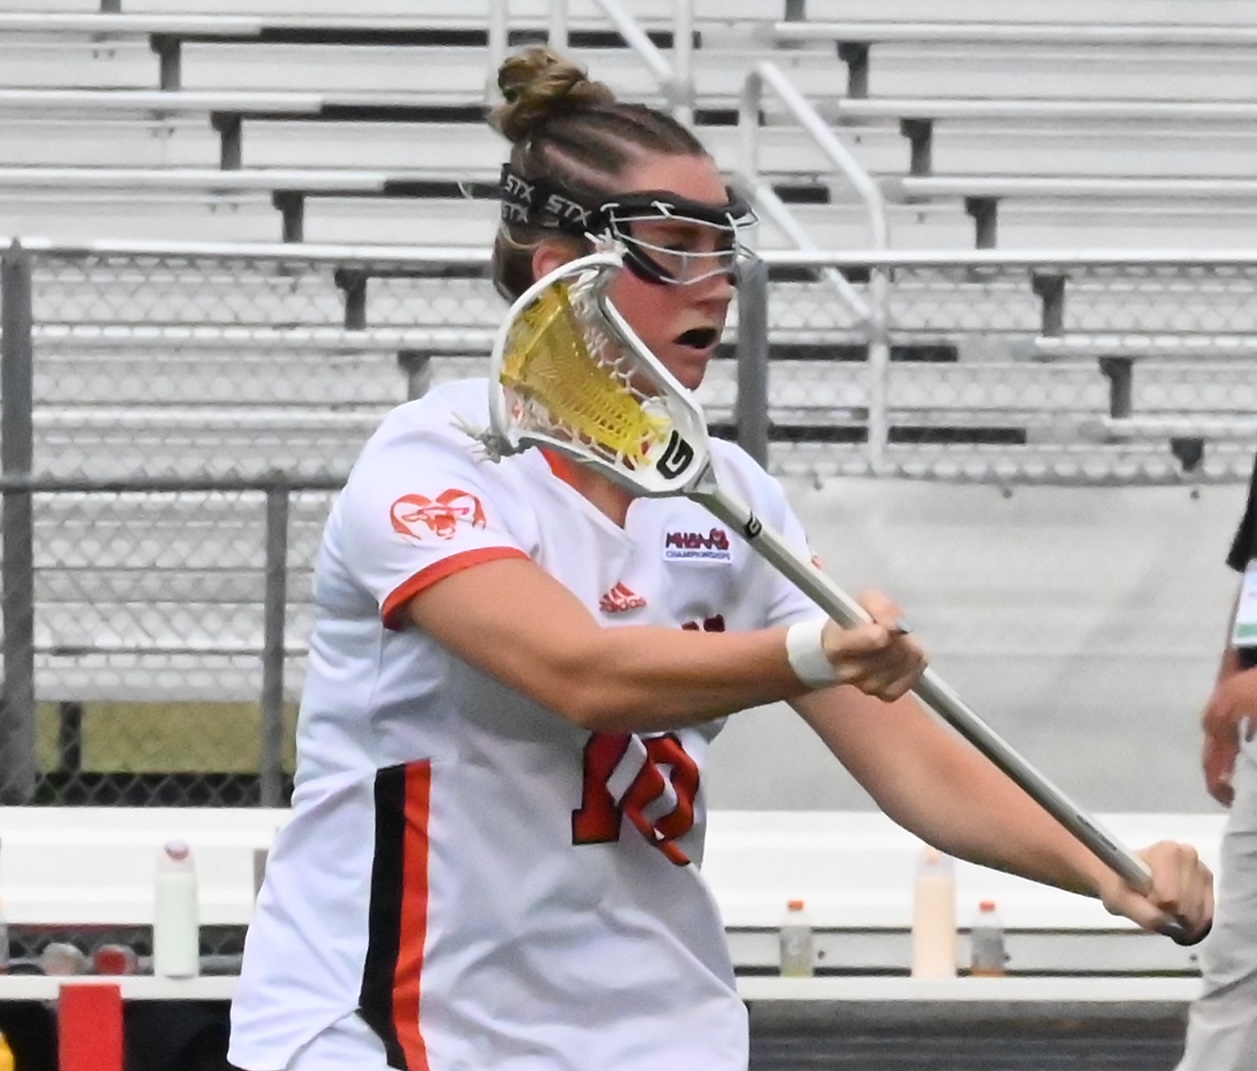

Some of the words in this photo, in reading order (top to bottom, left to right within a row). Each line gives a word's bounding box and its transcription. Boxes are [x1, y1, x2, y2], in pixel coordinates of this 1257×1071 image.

[503, 174, 535, 203] STX
[545, 194, 592, 228] STX
[570, 731, 701, 867] 10
